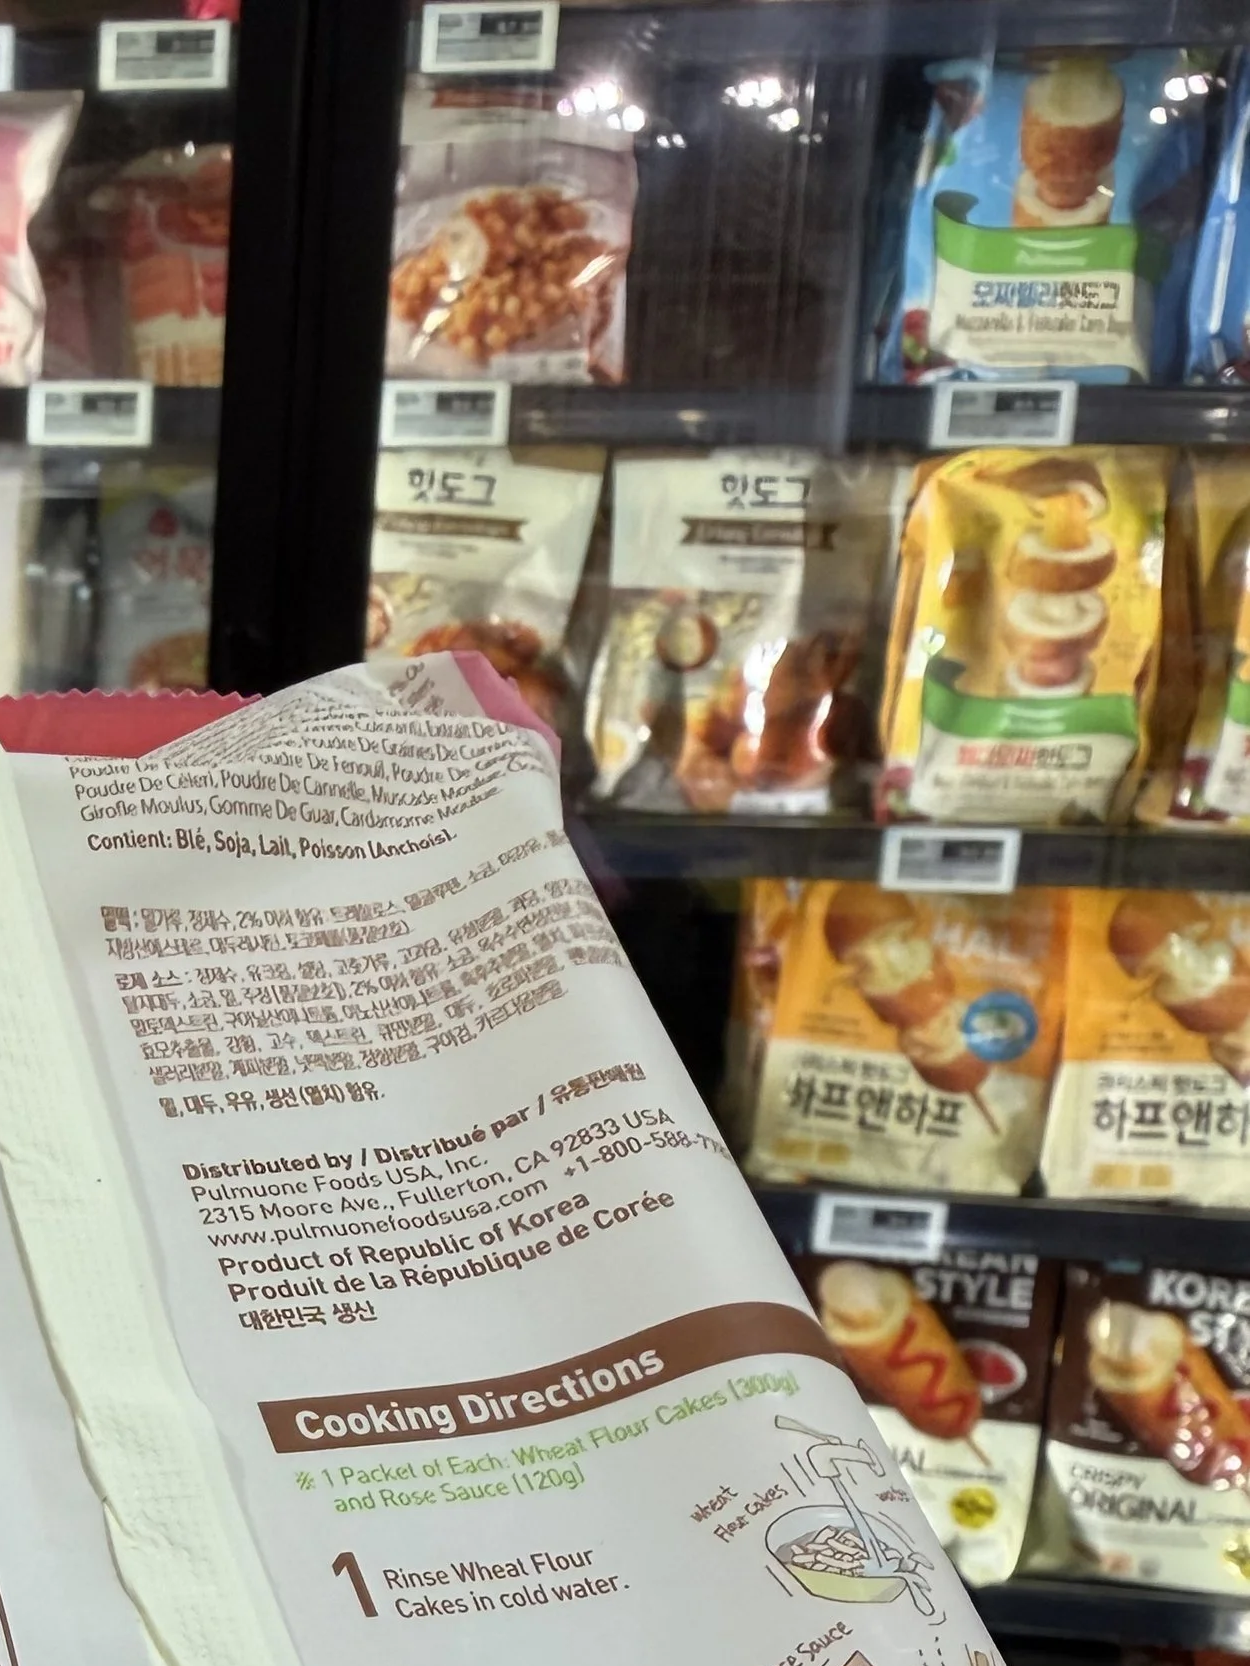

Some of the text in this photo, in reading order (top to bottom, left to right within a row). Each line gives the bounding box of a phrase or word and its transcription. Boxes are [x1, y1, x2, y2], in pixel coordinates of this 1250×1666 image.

[87, 830, 172, 851] Contient:
[175, 828, 211, 853] Blé,
[214, 830, 256, 858] Soja,
[258, 834, 297, 860] Lait,
[299, 837, 367, 859] Poisson
[182, 1154, 321, 1181] Distributed
[323, 1152, 352, 1171] by
[373, 1124, 486, 1164] Distribué
[490, 1107, 530, 1139] par
[199, 1108, 675, 1225] 2315 Moore Ave., Fullerton, CA 92833 USA
[191, 1155, 488, 1202] Pulmuone Foods USA, Inc.
[218, 1194, 590, 1276] Product of Republic of Korea
[227, 1190, 675, 1302] Produit de la République de Corée
[914, 1267, 1035, 1311] STYLE
[238, 1300, 378, 1331] 대한민국 생산
[296, 1351, 662, 1438] Cooking Directions
[1068, 1487, 1198, 1523] ORIGINAL
[330, 1551, 380, 1619] 1
[382, 1550, 593, 1590] Rinse Wheat Flour
[395, 1576, 630, 1618] Cakes in cold water.
